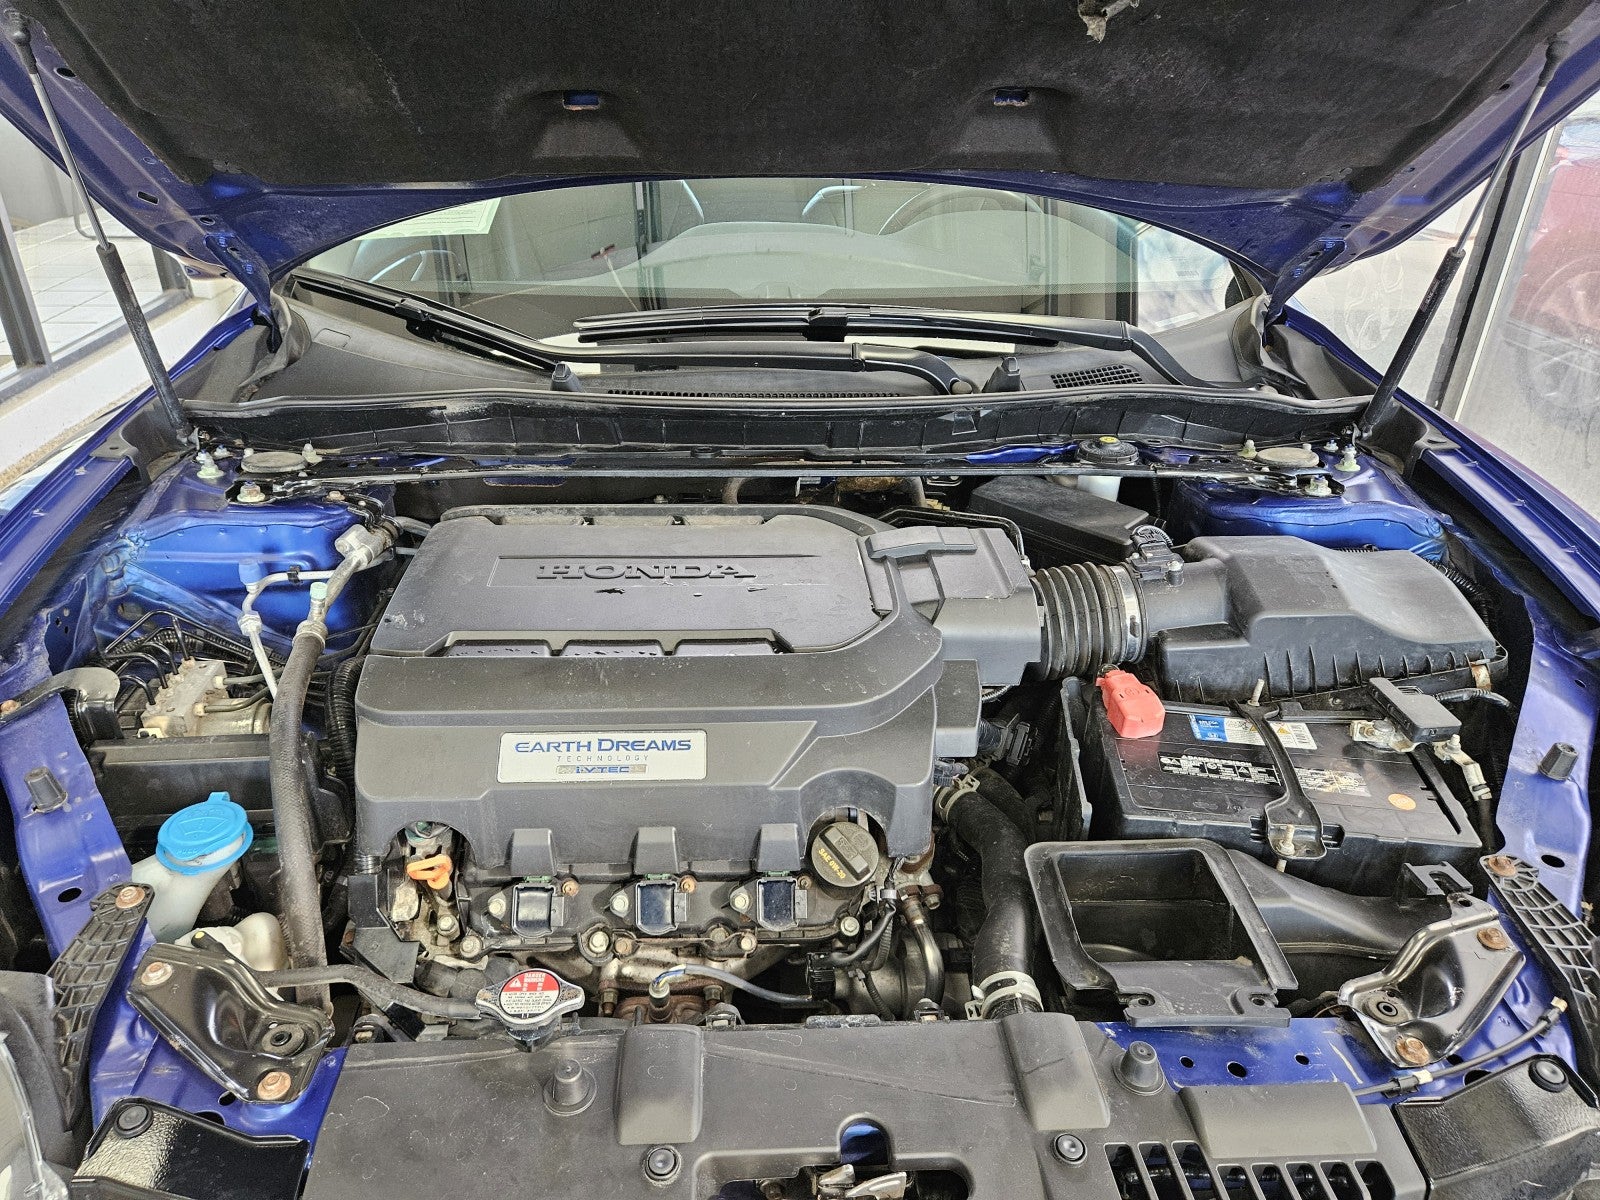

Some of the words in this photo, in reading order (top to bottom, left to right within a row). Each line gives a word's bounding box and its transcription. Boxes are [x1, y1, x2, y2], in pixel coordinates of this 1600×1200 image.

[536, 564, 757, 580] HONDA
[514, 739, 592, 753] EARTH
[597, 738, 692, 752] DREAMS
[556, 754, 650, 763] TECHNOLOGY
[818, 848, 832, 863] SAE
[829, 860, 846, 879] 0W-20
